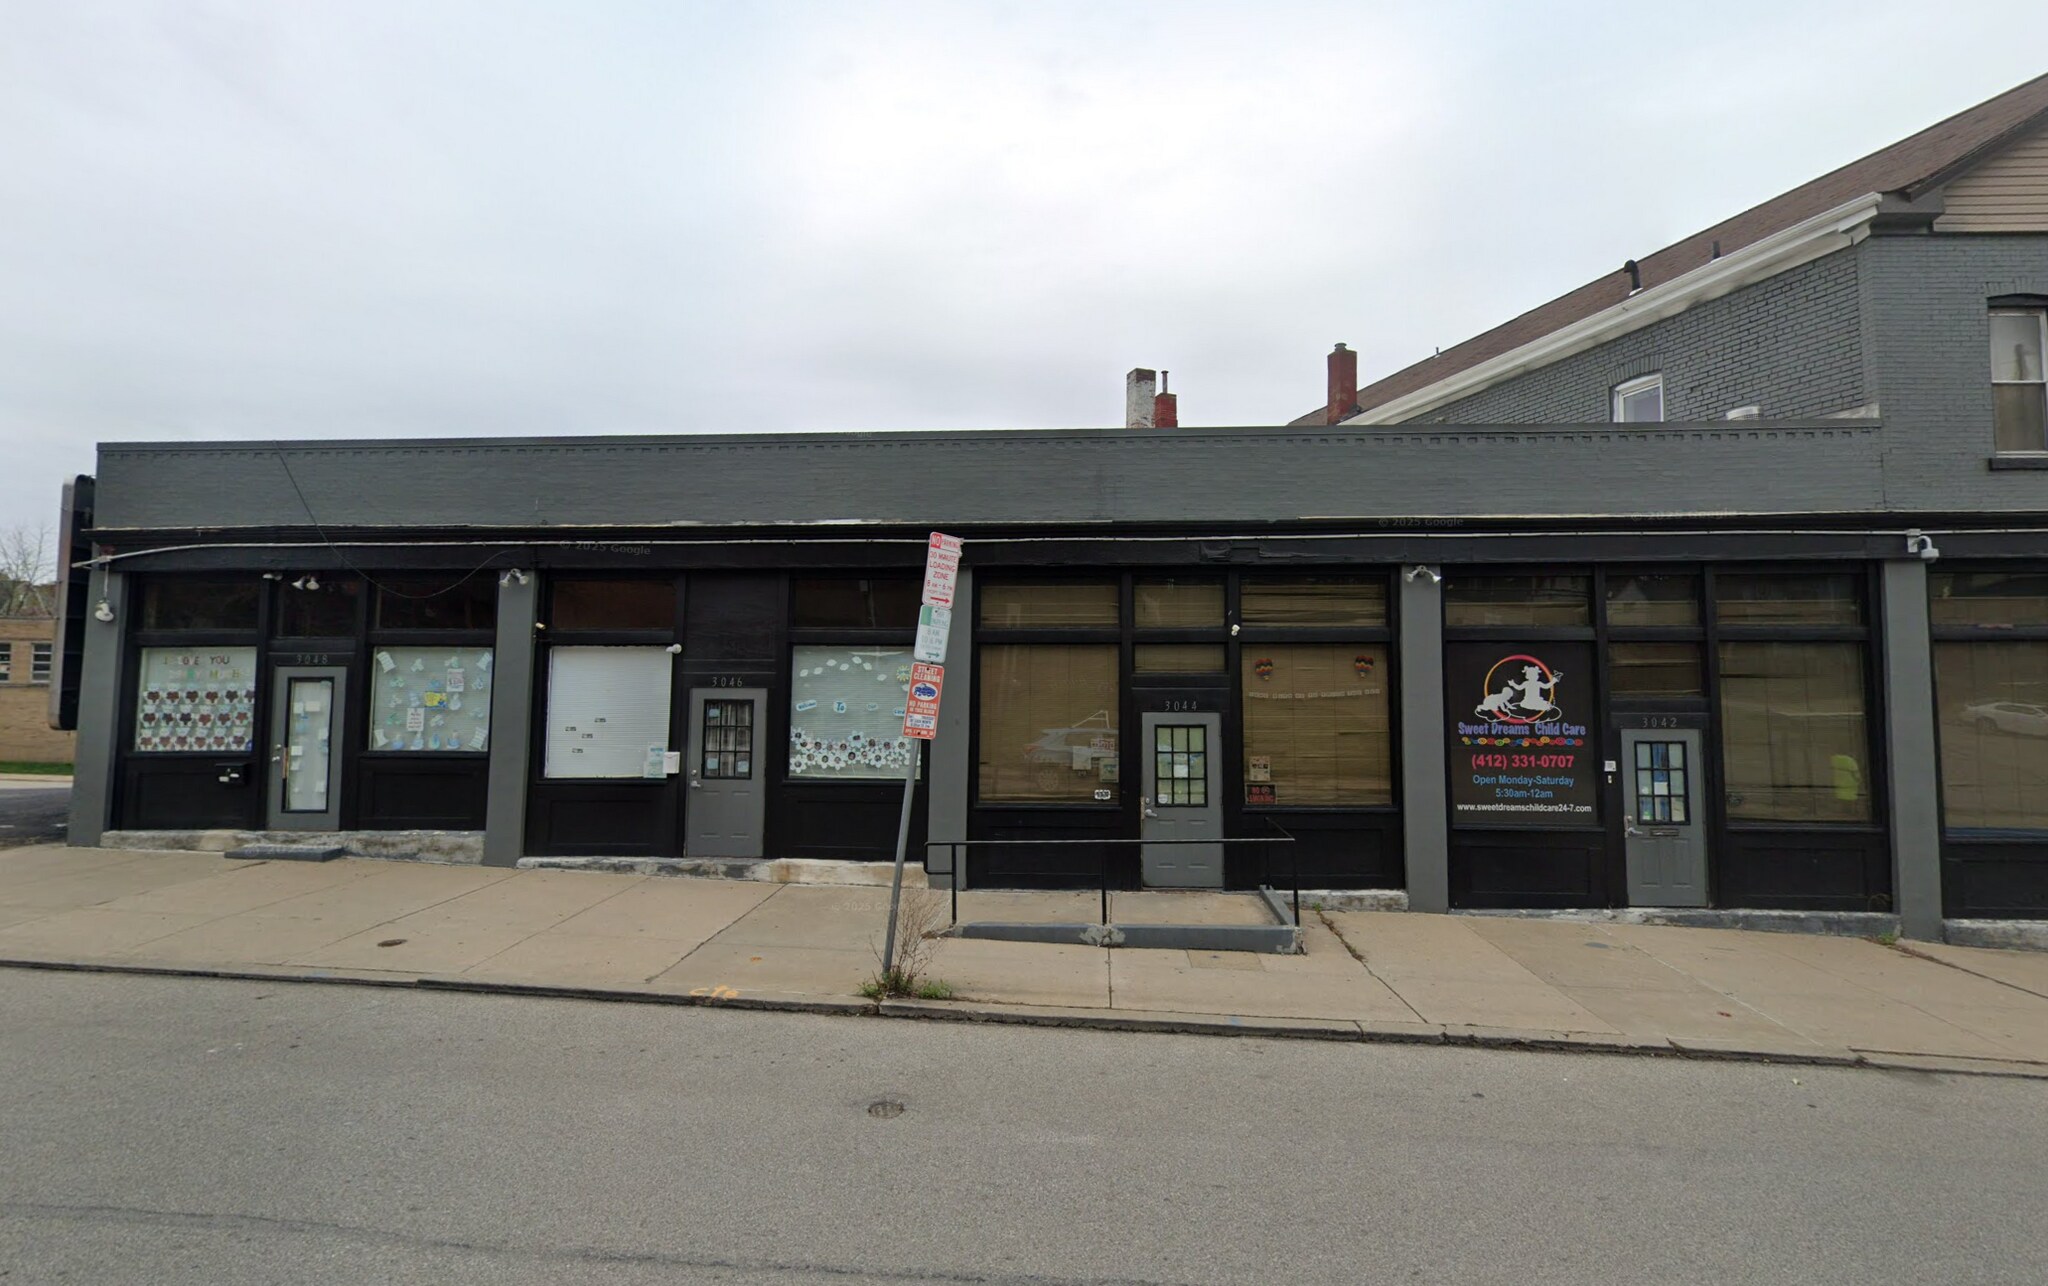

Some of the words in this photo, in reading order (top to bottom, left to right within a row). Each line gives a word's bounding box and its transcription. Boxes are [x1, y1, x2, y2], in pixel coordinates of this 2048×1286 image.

[931, 534, 941, 547] NO
[930, 550, 937, 559] 30
[929, 561, 956, 573] LOADING
[933, 571, 949, 581] ZONE
[209, 655, 231, 665] YOU
[296, 654, 328, 665] 3048
[918, 666, 938, 675] STREET
[712, 676, 743, 687] 3046
[913, 673, 940, 683] CLEANING
[836, 702, 844, 711] To
[917, 701, 937, 709] PARKING
[1165, 700, 1197, 711] 3044
[1642, 717, 1678, 728] 3042
[1457, 721, 1489, 735] Sweet
[1491, 722, 1530, 735] Dreams
[1535, 722, 1560, 735] Child
[1562, 723, 1586, 736] Care
[1471, 754, 1508, 770] (412)
[1512, 754, 1575, 768] 331-0707
[1473, 774, 1496, 786] Open
[1499, 775, 1574, 787] Monday-Saturday
[1495, 788, 1553, 798] 5:30am-12am
[1456, 802, 1592, 813] www.sweetdreamschildcare24-7.com
